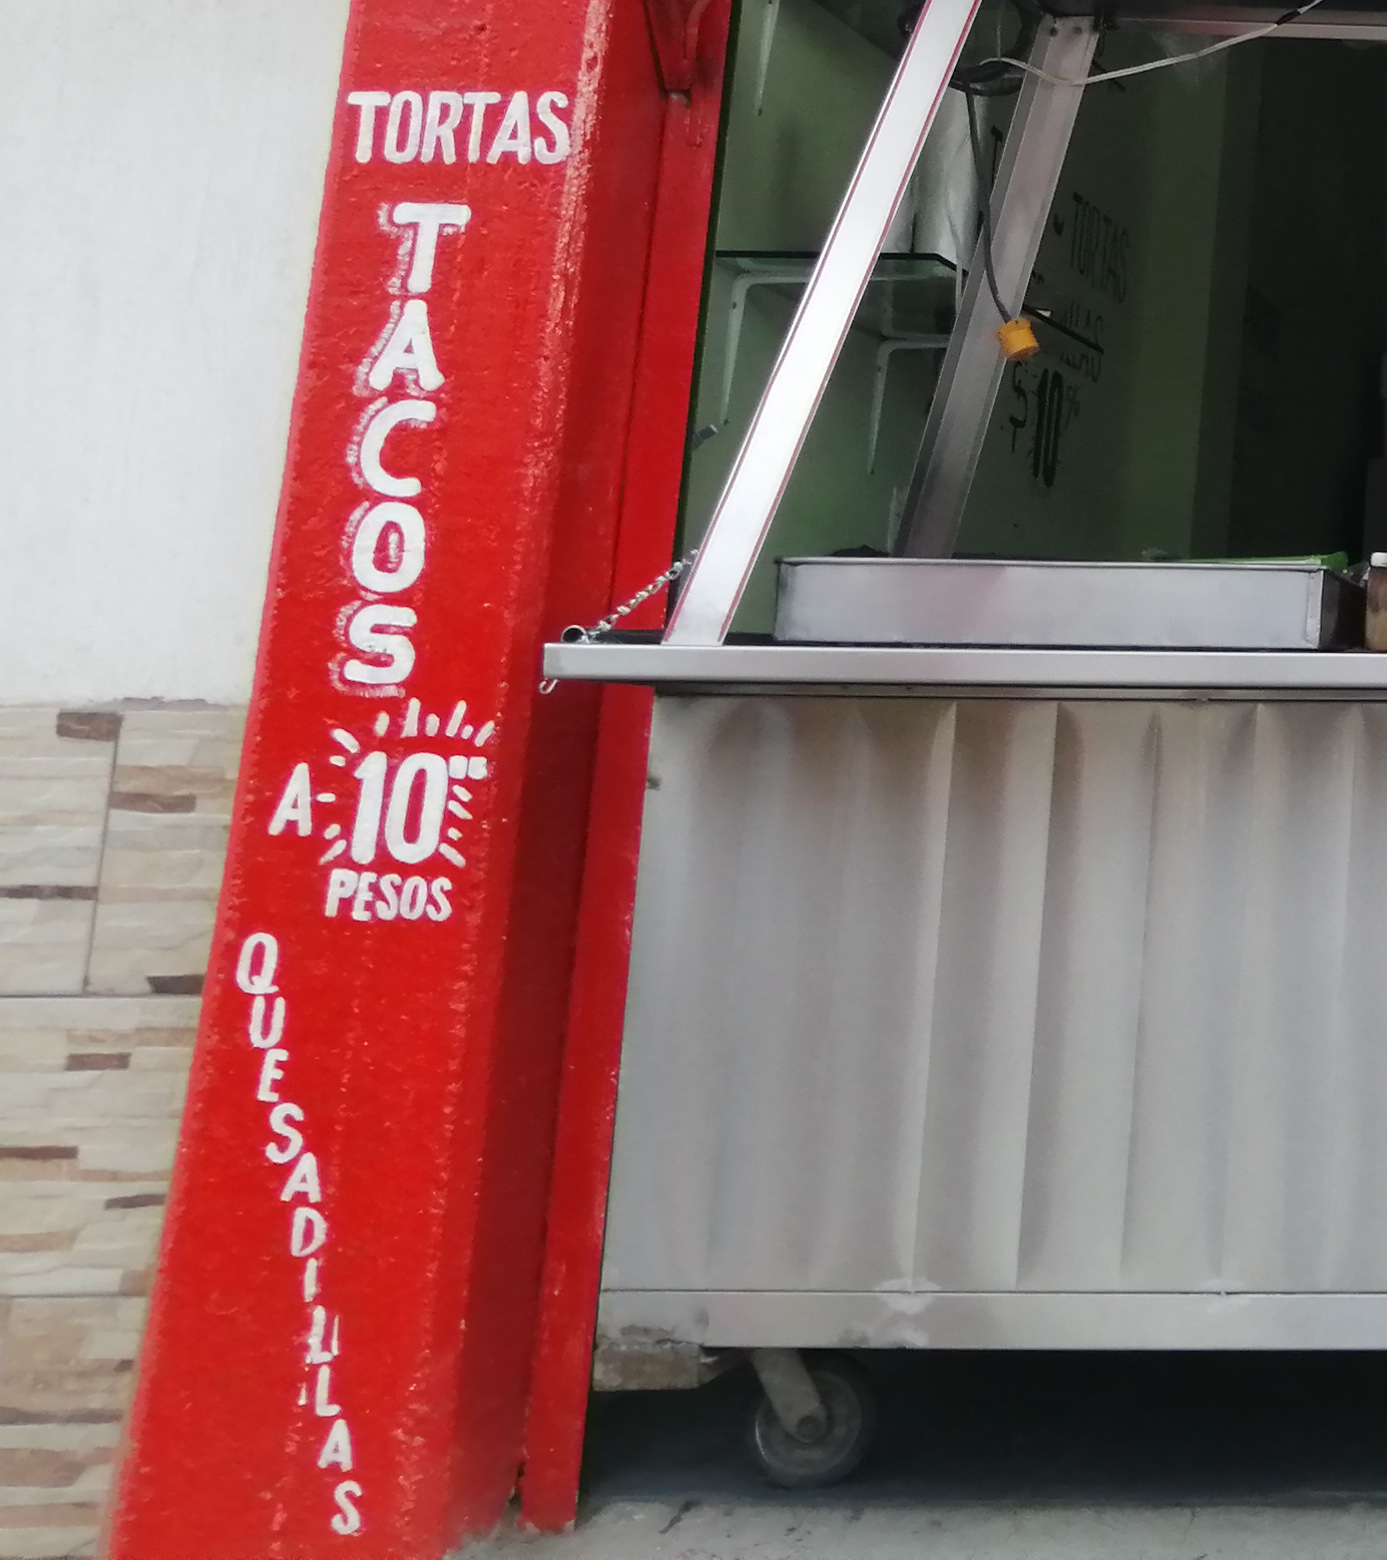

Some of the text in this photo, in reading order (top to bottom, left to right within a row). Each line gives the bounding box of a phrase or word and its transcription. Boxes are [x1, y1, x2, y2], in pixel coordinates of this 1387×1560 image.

[346, 90, 574, 165] TORTAS
[1069, 191, 1130, 304] TORTAS
[336, 201, 472, 686] TACOS
[268, 761, 313, 837] A
[325, 868, 453, 923] PESOS
[235, 932, 363, 1537] QUESADILLAS
